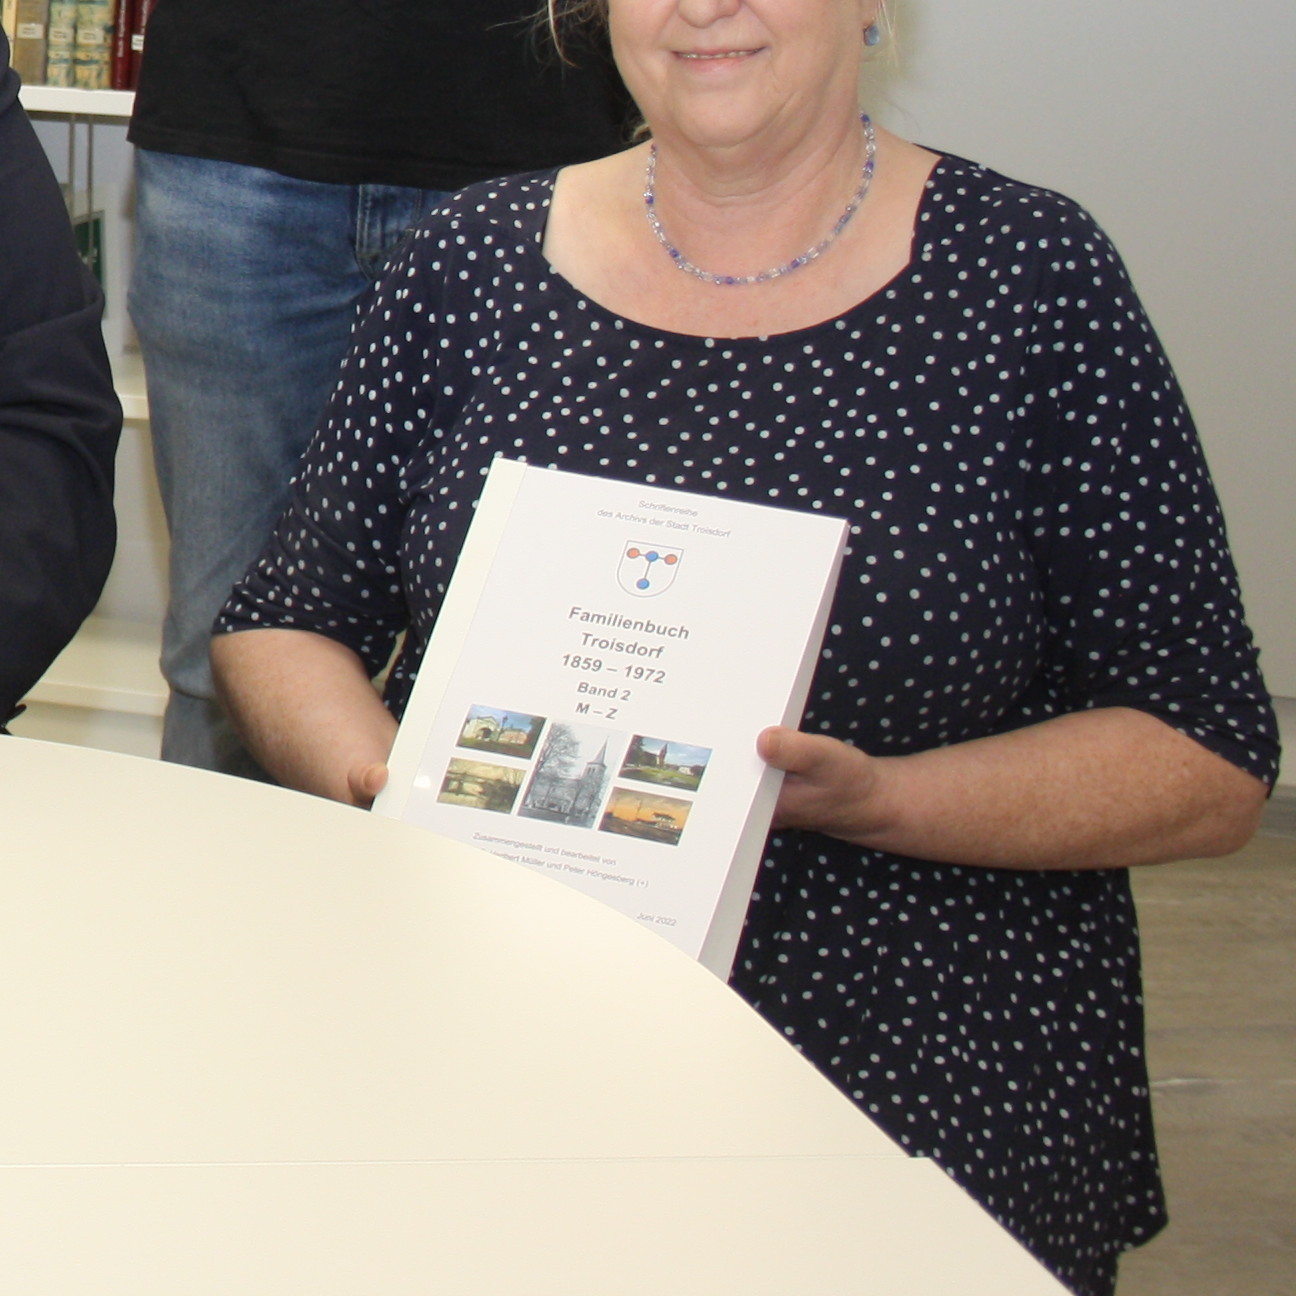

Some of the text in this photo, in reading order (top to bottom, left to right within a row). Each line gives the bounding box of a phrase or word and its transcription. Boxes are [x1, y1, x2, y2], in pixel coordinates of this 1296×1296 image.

[597, 509, 731, 538] des Archivs der Stadt Troisdorf
[568, 606, 690, 639] Familienbuch
[581, 631, 665, 659] Troisdorf
[562, 653, 603, 673] 1859
[624, 665, 666, 684] 1972
[576, 681, 631, 701] Band 2
[575, 702, 618, 720] M Z
[544, 846, 559, 855] und
[561, 848, 601, 863] bearbeitet
[602, 858, 616, 866] von
[546, 861, 561, 871] und
[563, 865, 585, 876] Peter
